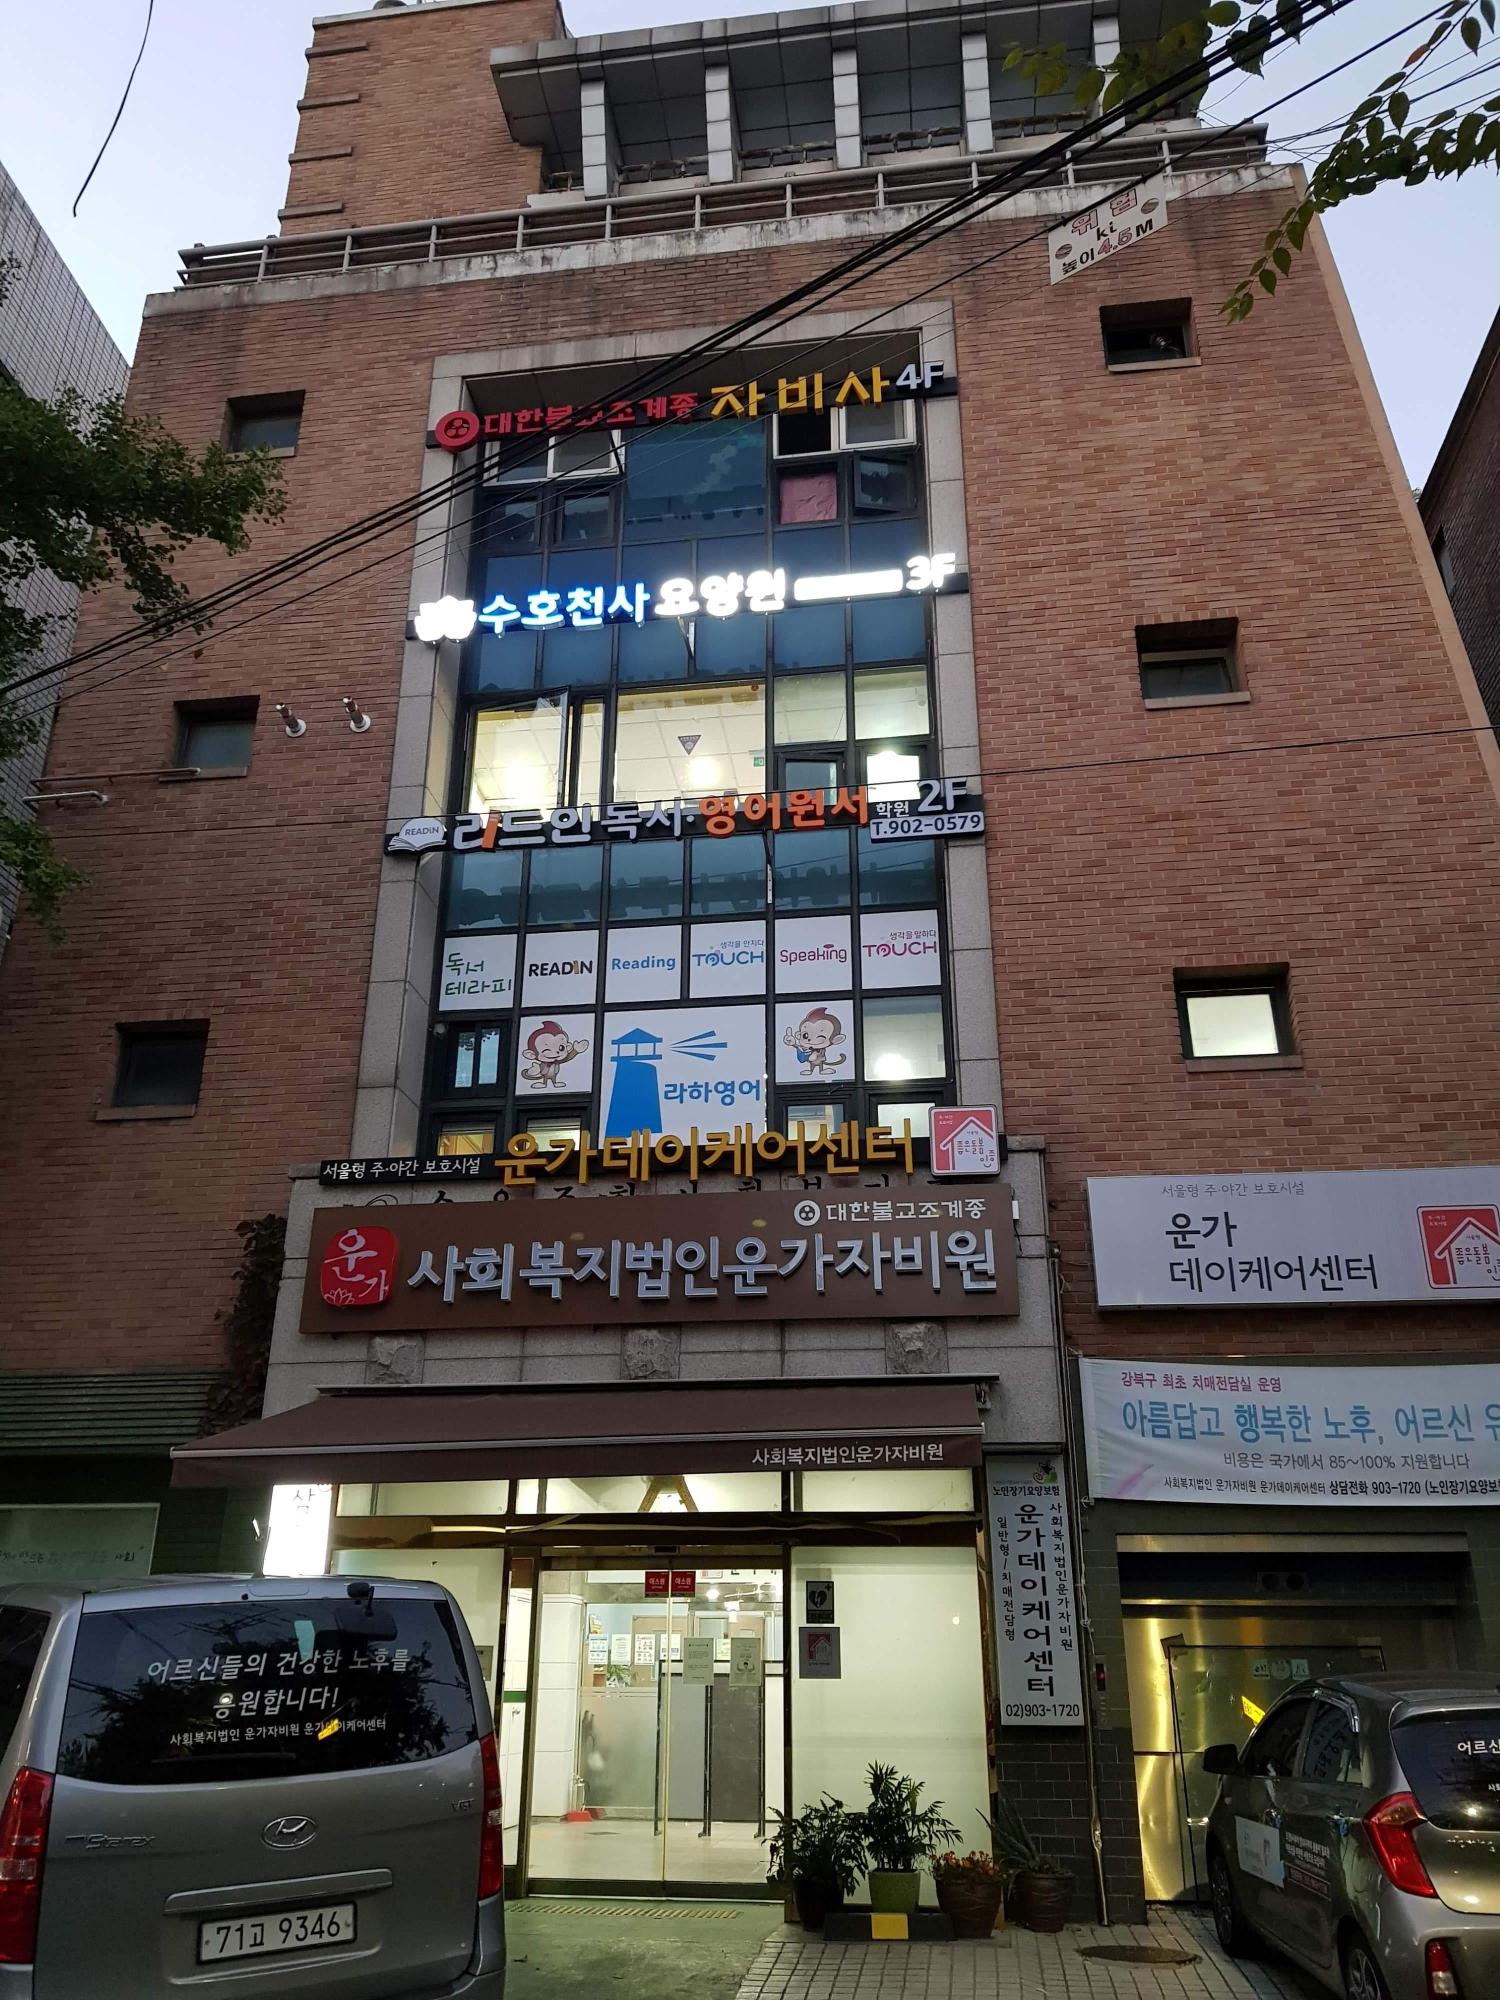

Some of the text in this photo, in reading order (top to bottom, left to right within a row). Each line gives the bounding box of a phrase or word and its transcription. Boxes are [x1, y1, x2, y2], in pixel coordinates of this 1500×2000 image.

[895, 360, 944, 390] 4F
[711, 366, 890, 420] 자비사
[906, 552, 956, 591] 3F
[478, 566, 786, 636] 수호천사 요양원
[917, 779, 968, 813] 2F
[875, 801, 910, 819] 학원
[872, 814, 981, 836] T.902-0579
[692, 950, 764, 967] TOUCH
[780, 944, 847, 966] Speaking
[862, 941, 937, 958] TOUCH
[446, 952, 484, 976] 독서
[611, 955, 676, 970] Reading
[445, 979, 512, 996] 테라피
[663, 1079, 760, 1106] 라하영어
[495, 1118, 914, 1186] 운가데이케어센터
[323, 1161, 367, 1180] 서울형
[422, 1157, 481, 1175] 보호시설
[1161, 1184, 1199, 1198] 서울형
[1253, 1181, 1305, 1195] 보호시설
[826, 1198, 987, 1222] 대한불교조계종
[1165, 1211, 1237, 1249] 운가
[1169, 1254, 1379, 1292] 데이케어센터
[1121, 1371, 1282, 1392] 강북구 최초 치매전담실 운영
[1122, 1400, 1225, 1440] 아름답고
[1234, 1404, 1312, 1443] 행복한
[1324, 1405, 1384, 1445] 노후,
[1394, 1404, 1475, 1443] 어르신
[1224, 1453, 1470, 1470] 비용은 국가에서 85~100% 지원합니다
[993, 1485, 1060, 1496] 노인장기요양보험
[1164, 1476, 1212, 1490] 사회복지법인
[1216, 1479, 1257, 1493] 운가자비원
[1329, 1480, 1368, 1495] 상담전화
[1373, 1481, 1421, 1494] 903-1720
[1014, 1504, 1054, 1697] 운가데이케어센터
[148, 1648, 411, 1683] 어르신들의 건강한 노후를
[213, 1687, 339, 1720] 응원합니다!
[1005, 1704, 1080, 1719] 02)903-1720
[170, 1728, 240, 1746] 사회복지법인
[245, 1724, 300, 1740] 운가자비원
[216, 1910, 341, 1953] 71고 9346
